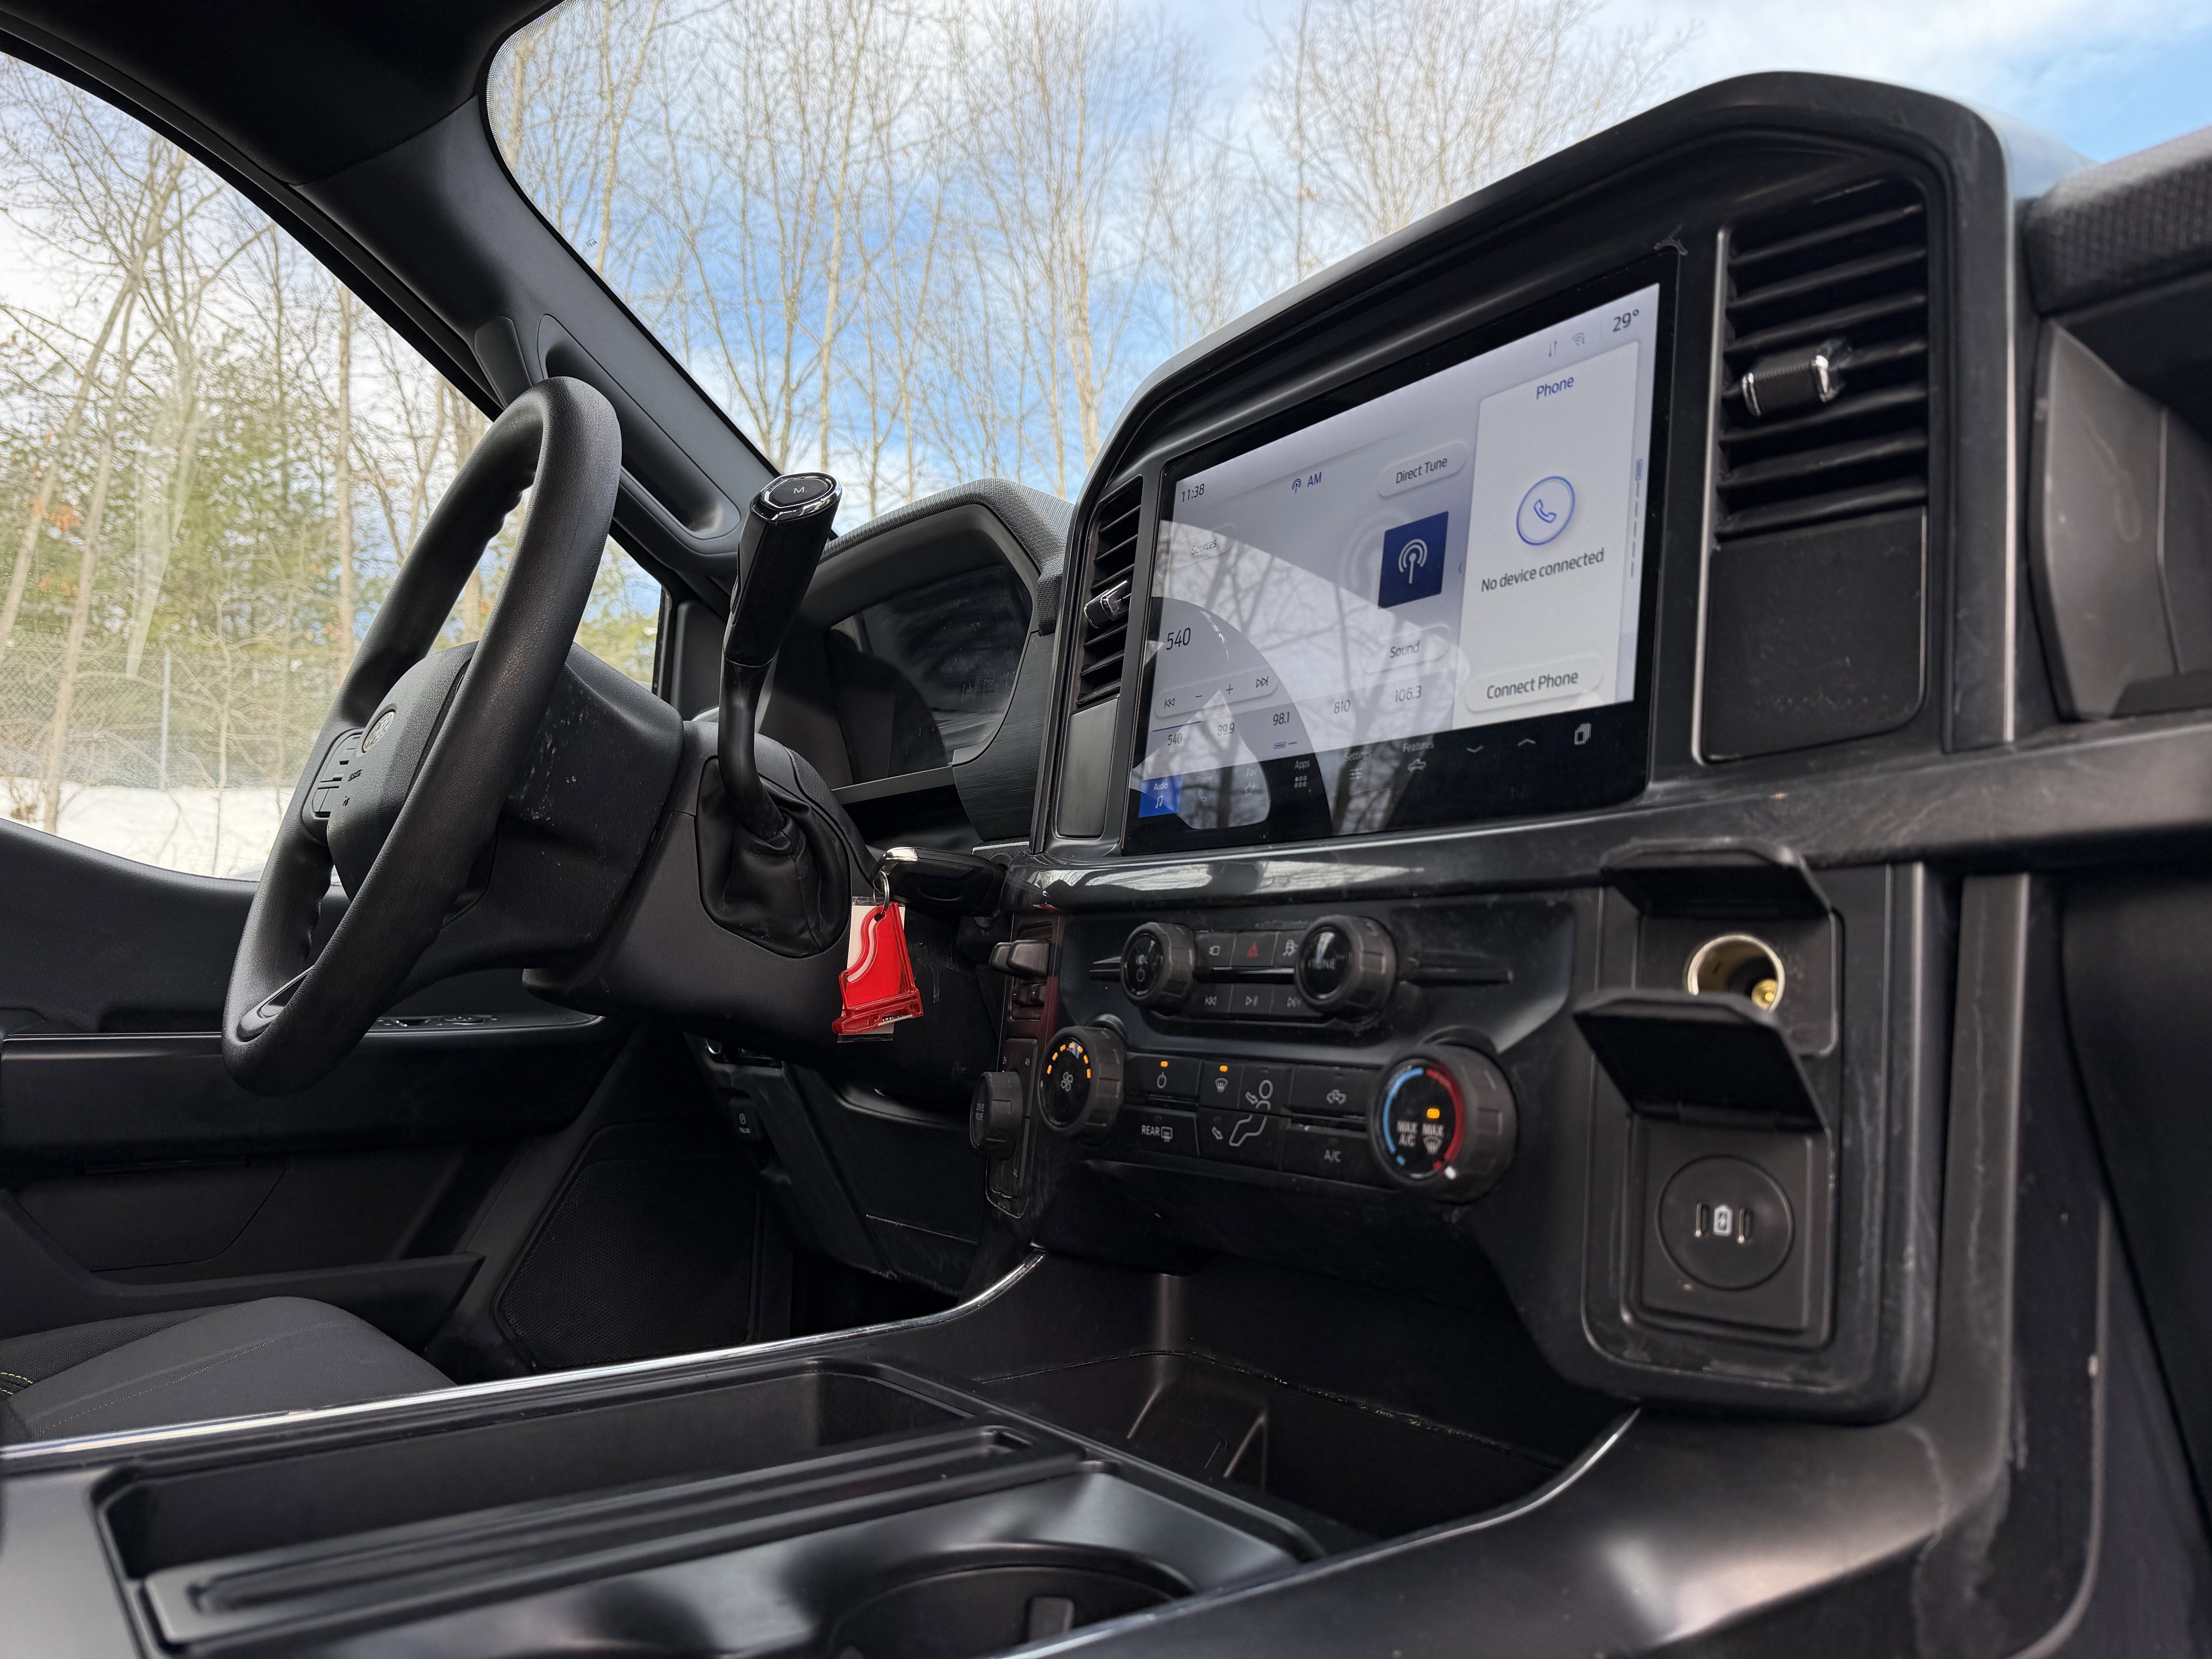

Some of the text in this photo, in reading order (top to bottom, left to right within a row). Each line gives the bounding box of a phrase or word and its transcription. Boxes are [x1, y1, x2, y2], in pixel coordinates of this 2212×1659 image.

[1612, 309, 1640, 332] 29°
[1536, 377, 1574, 399] Phone
[1396, 457, 1448, 483] Direct Tune
[1307, 472, 1322, 488] AM
[1182, 484, 1205, 502] 11:38
[1191, 539, 1217, 555] Sources
[1481, 548, 1604, 592] No device connected
[1166, 627, 1191, 650] 540
[1389, 641, 1420, 659] Sound
[1486, 671, 1578, 699] Connect Phone
[1395, 685, 1422, 702] 106.3
[1333, 699, 1351, 714] 810
[1273, 712, 1290, 725] 98.1
[1217, 723, 1235, 736] 89.9
[1168, 733, 1182, 745] 540
[1294, 760, 1310, 770] Apps
[1153, 782, 1168, 791] Audio
[1141, 1125, 1160, 1137] REAR
[1397, 1121, 1418, 1134] MAX
[1422, 1123, 1444, 1137] MAX
[1399, 1134, 1416, 1147] A/C
[1324, 1150, 1342, 1163] A/C
